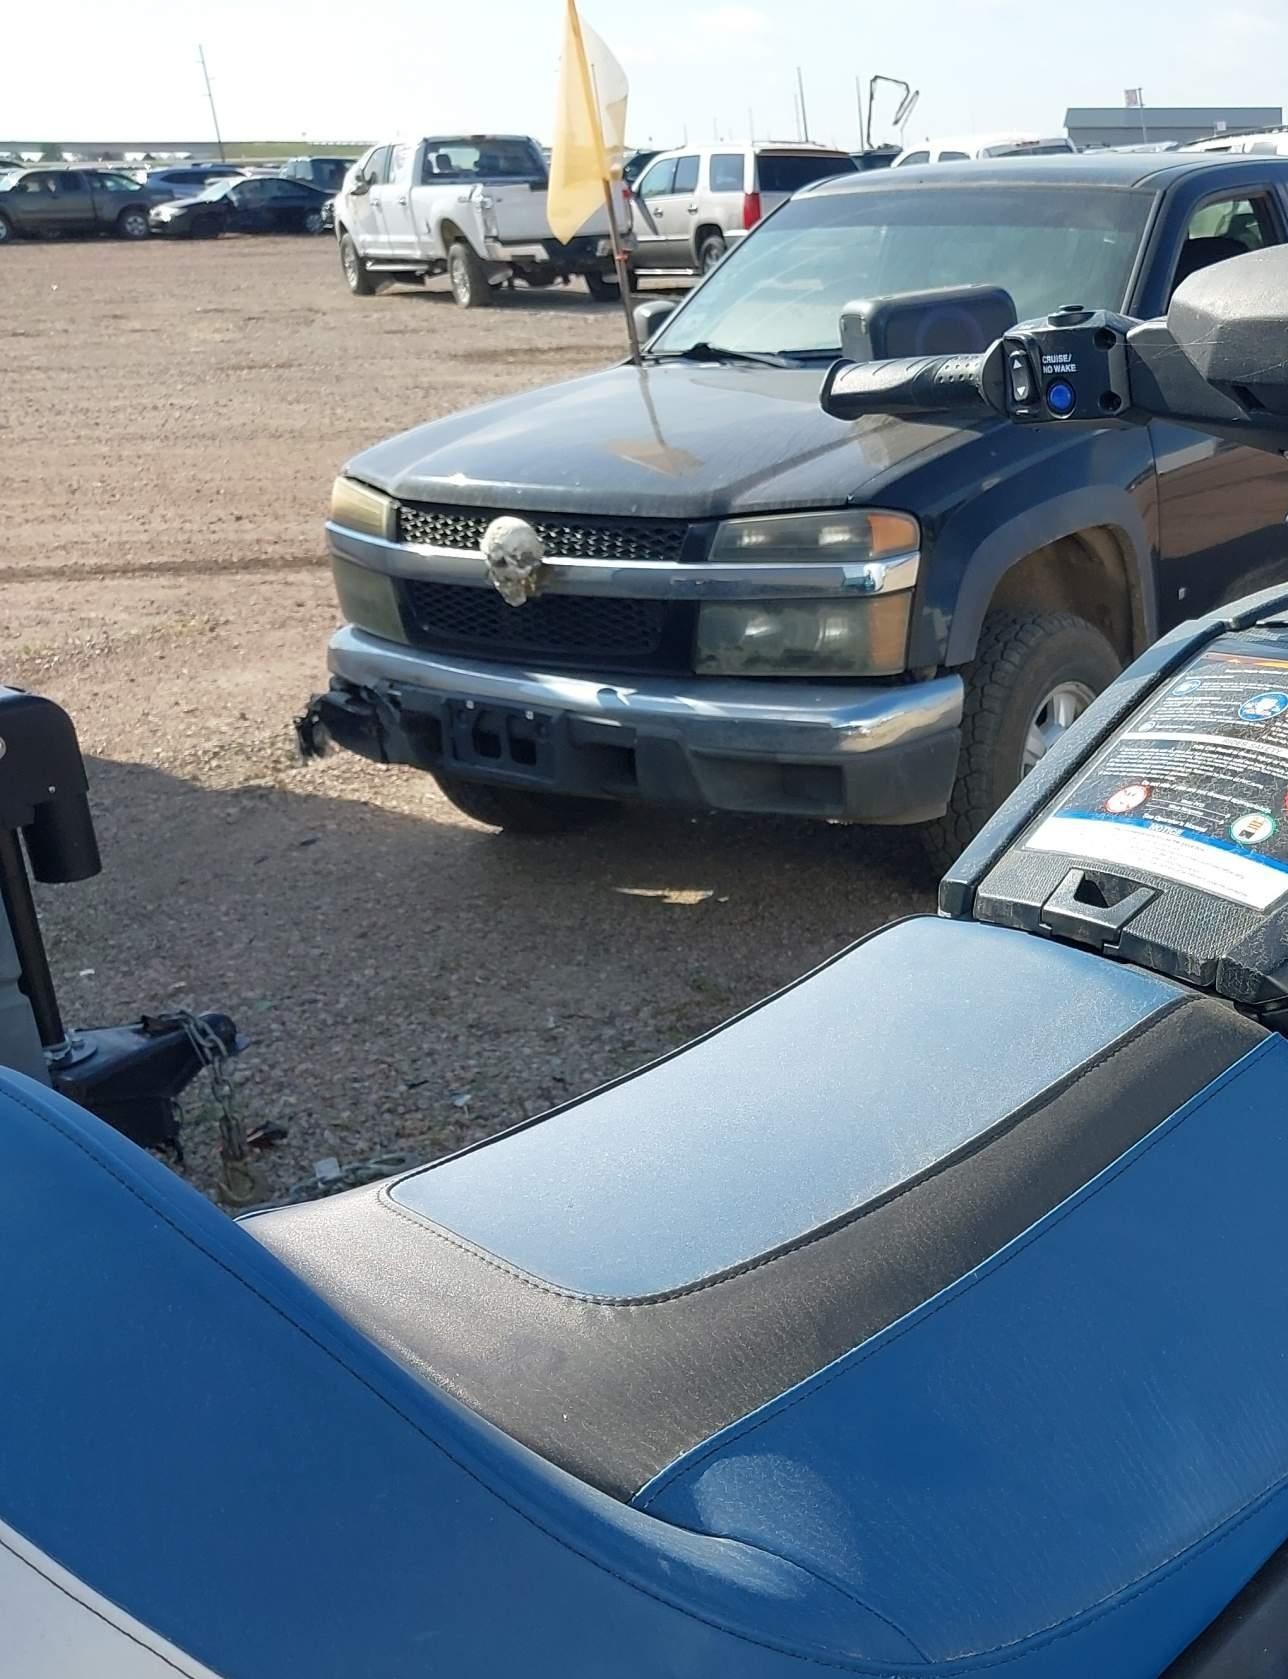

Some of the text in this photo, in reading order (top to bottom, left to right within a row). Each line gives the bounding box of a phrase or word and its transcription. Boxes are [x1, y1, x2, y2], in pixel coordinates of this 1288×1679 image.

[1042, 353, 1072, 364] CRUISE/
[1043, 363, 1077, 374] NO WAKE
